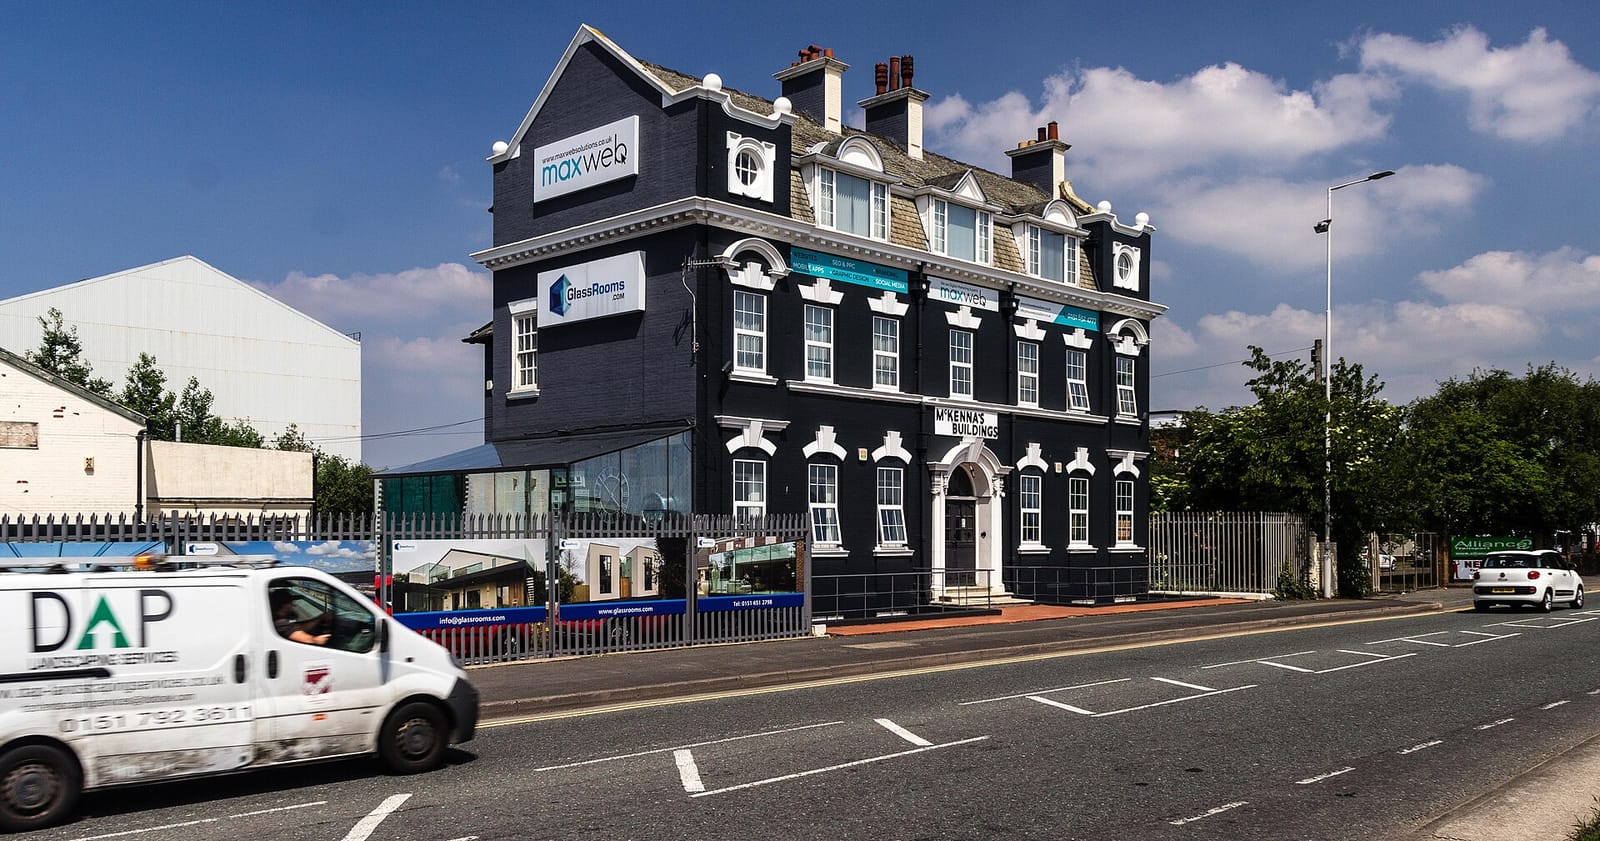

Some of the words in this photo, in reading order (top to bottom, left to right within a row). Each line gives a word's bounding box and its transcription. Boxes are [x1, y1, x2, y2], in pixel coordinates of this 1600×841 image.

[542, 135, 612, 164] www.maxwebsolutions.co.uk
[542, 133, 627, 187] maxweb
[792, 262, 812, 272] MOBILE
[812, 265, 825, 274] APPS
[875, 277, 892, 287] SOCIAL
[567, 280, 625, 301] GlassRooms
[940, 284, 987, 307] maxweb
[952, 423, 999, 438] BUILDINGS
[1455, 539, 1532, 550] Alliance
[598, 606, 654, 616] www.glassrooms.com
[29, 590, 176, 653] DAP
[439, 615, 506, 625] info@glassrooms.com
[119, 650, 180, 665] SERVICES
[58, 714, 127, 733] 0151
[137, 709, 186, 726] 792
[192, 704, 252, 723] 3611
